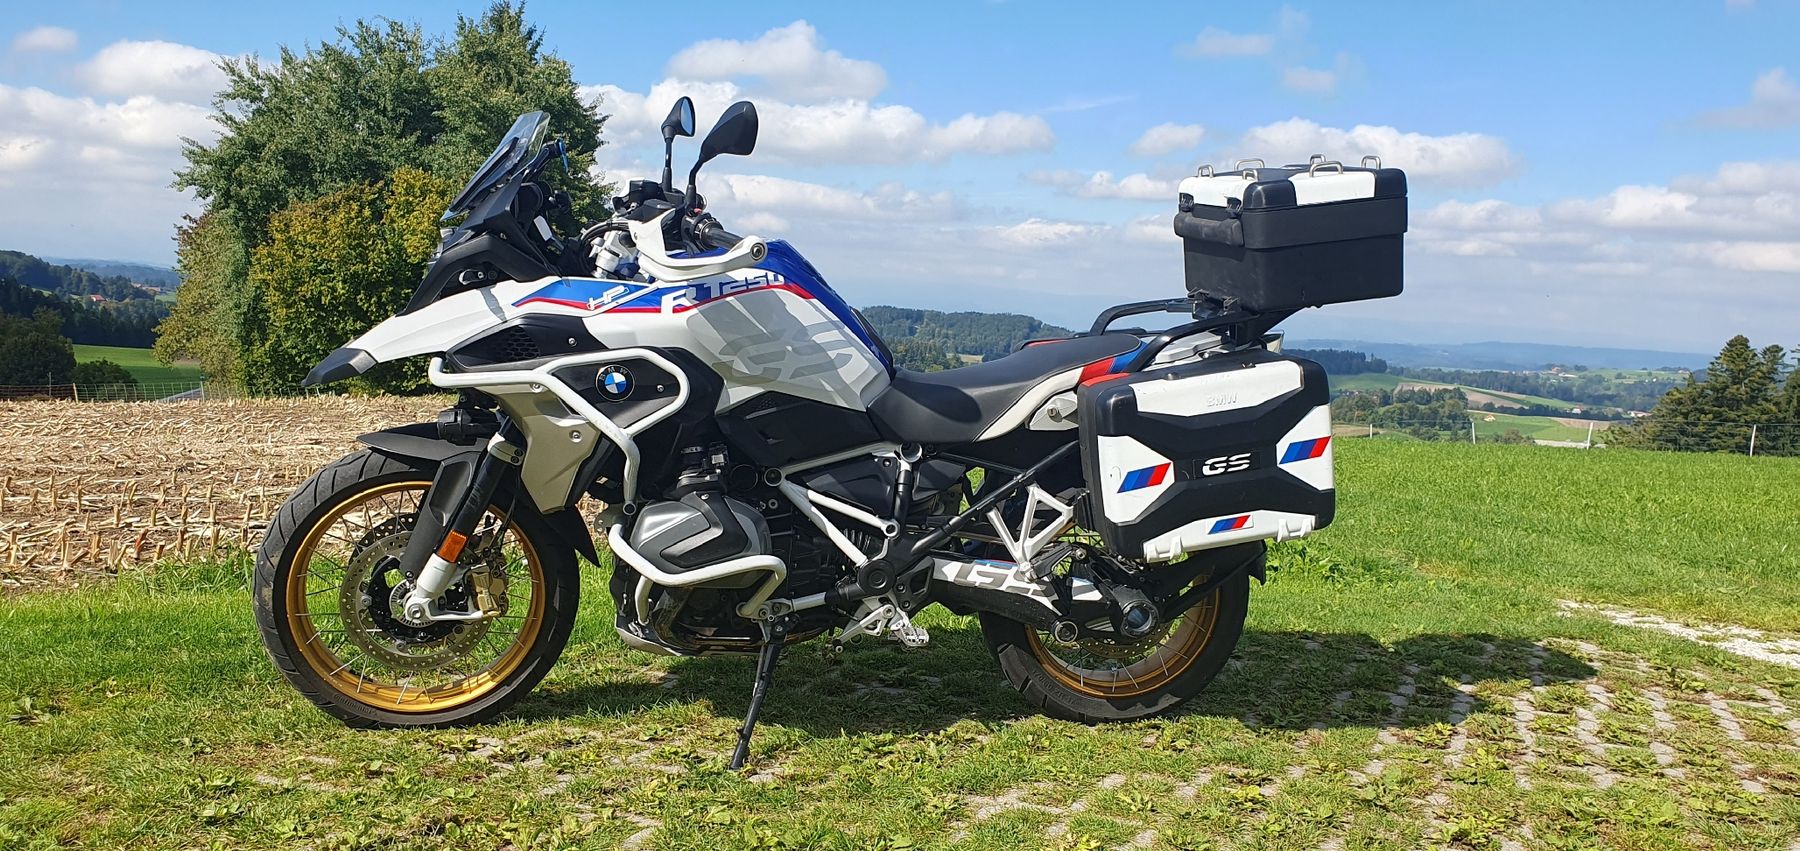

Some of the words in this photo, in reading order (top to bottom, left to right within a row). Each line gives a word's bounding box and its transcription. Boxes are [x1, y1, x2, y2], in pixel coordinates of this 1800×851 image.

[587, 285, 629, 310] HP
[599, 366, 627, 380] BMW
[1207, 392, 1239, 407] BMW
[1202, 453, 1251, 475] GS
